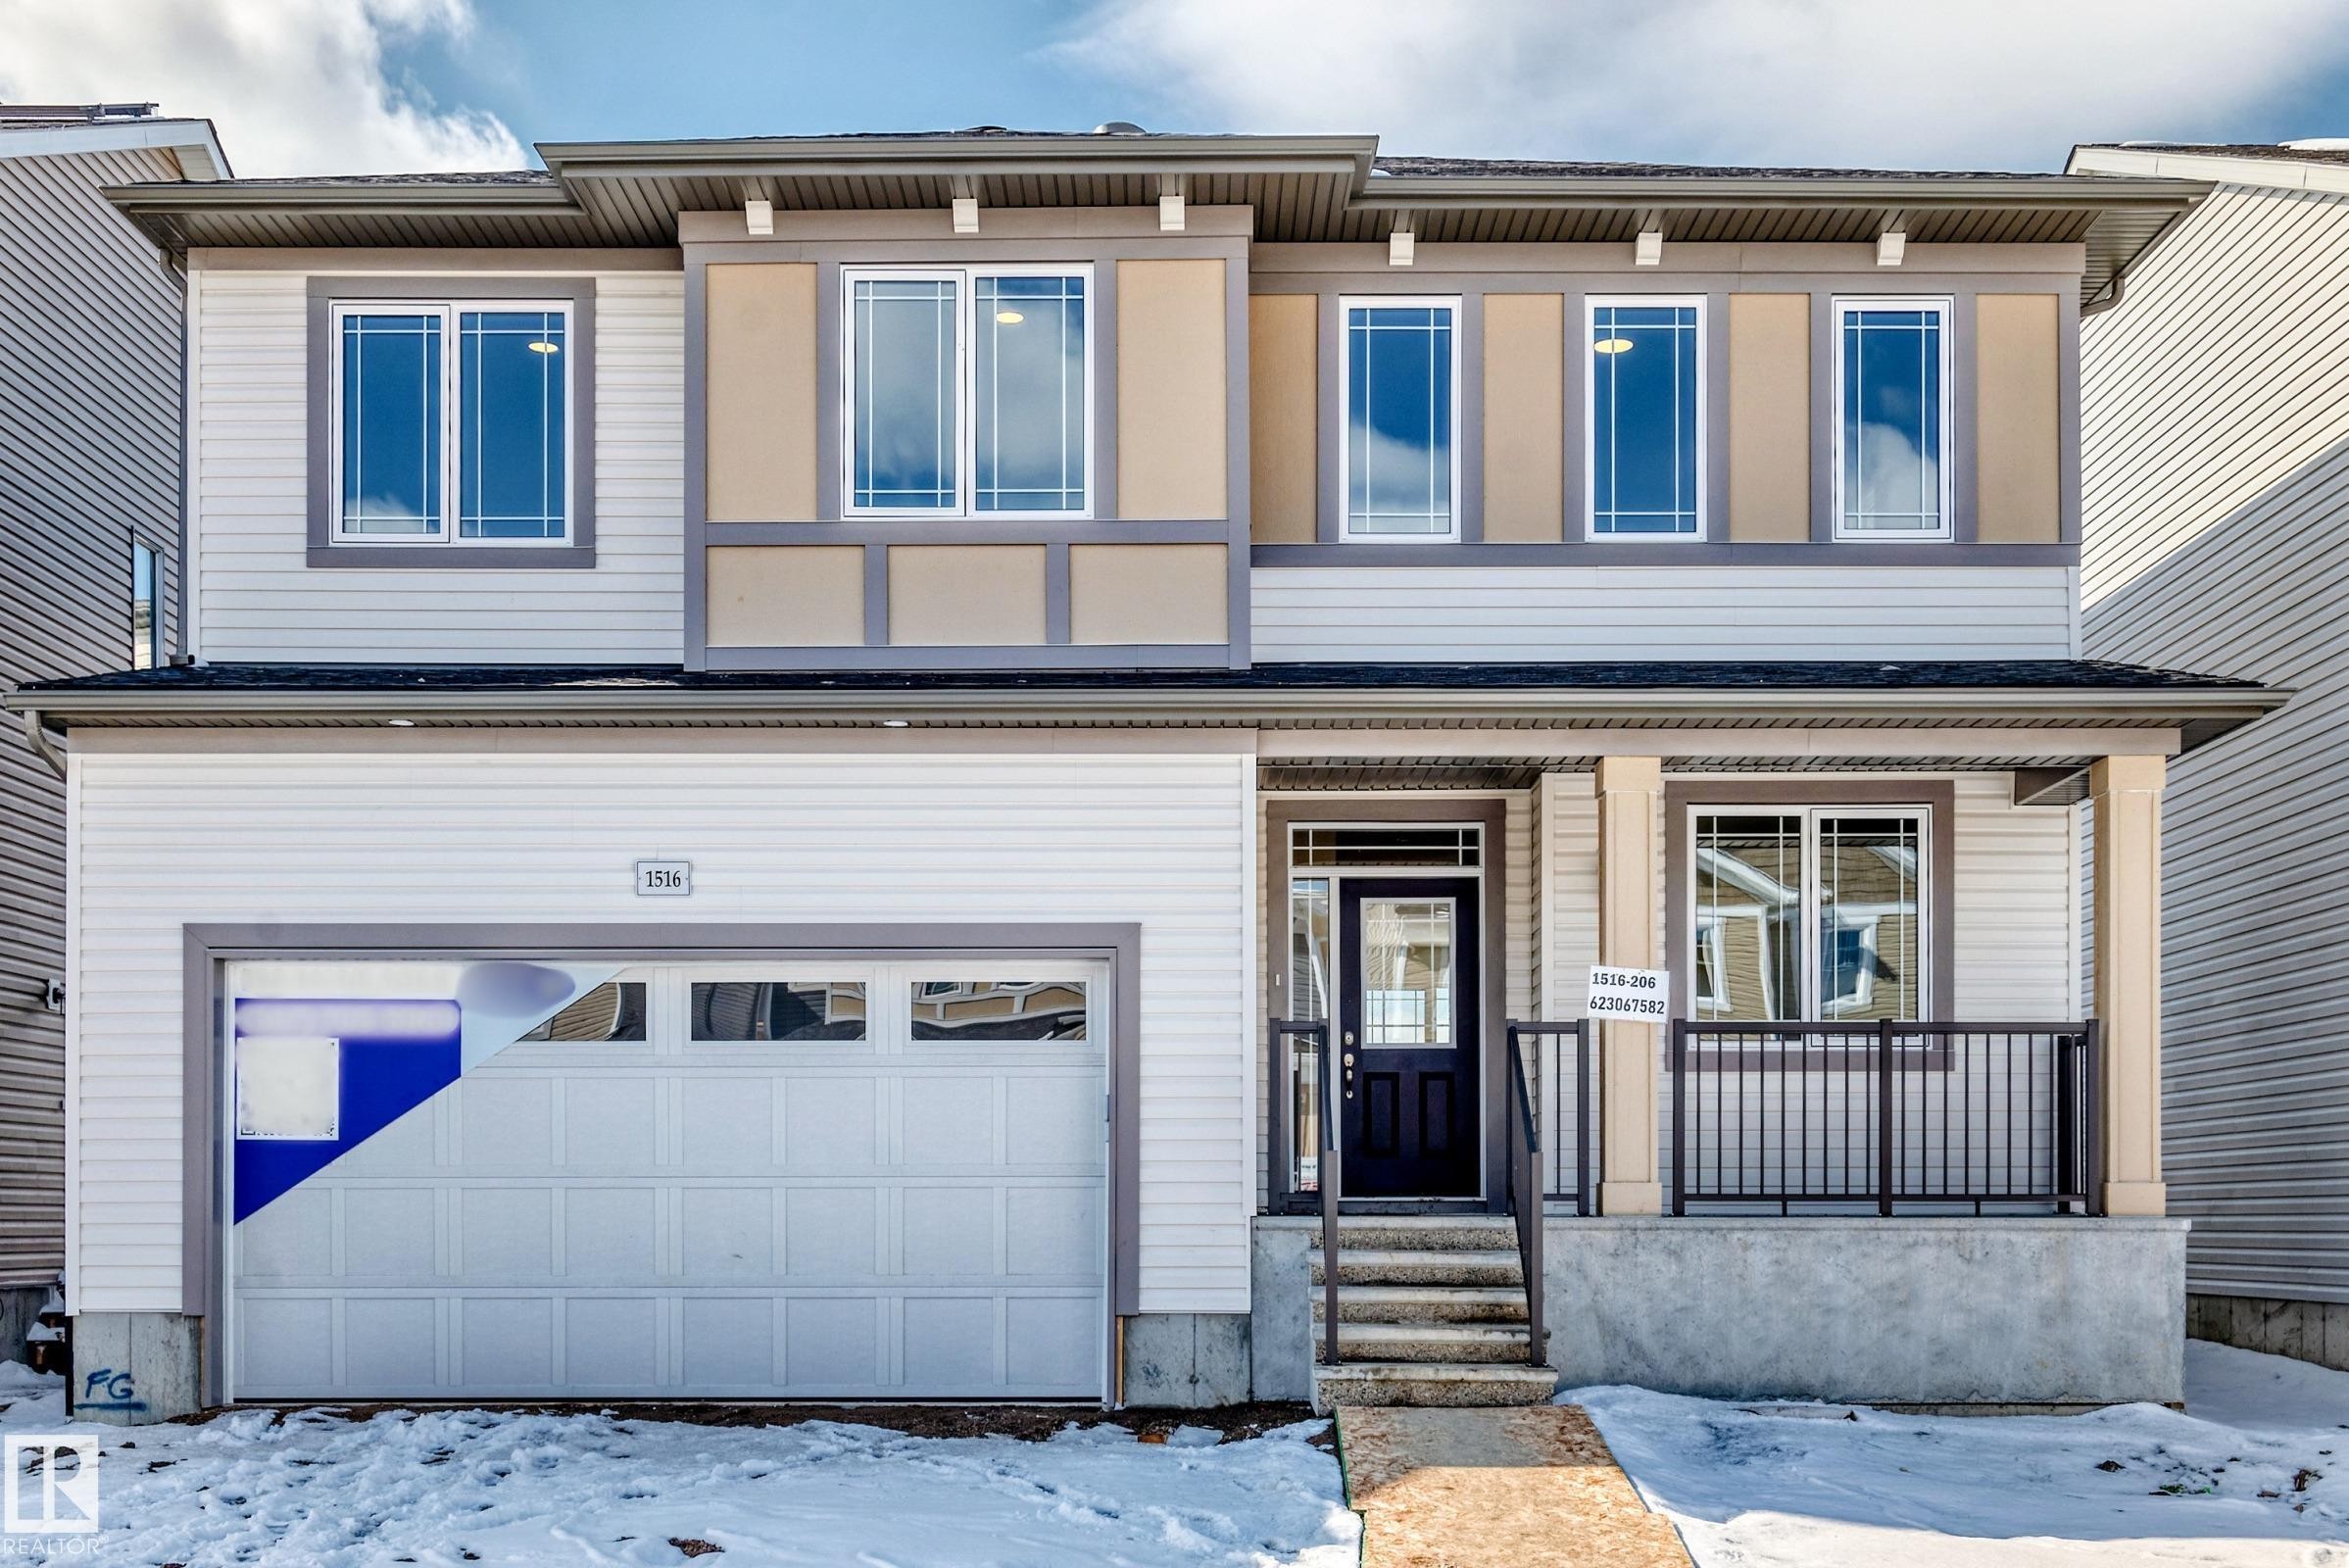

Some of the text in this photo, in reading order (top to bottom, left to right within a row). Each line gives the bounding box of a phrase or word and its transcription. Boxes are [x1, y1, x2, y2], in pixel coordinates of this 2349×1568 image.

[646, 870, 681, 887] 1516
[1592, 972, 1656, 989] 1516-206
[1590, 996, 1665, 1015] 623067582
[85, 1369, 134, 1399] FG
